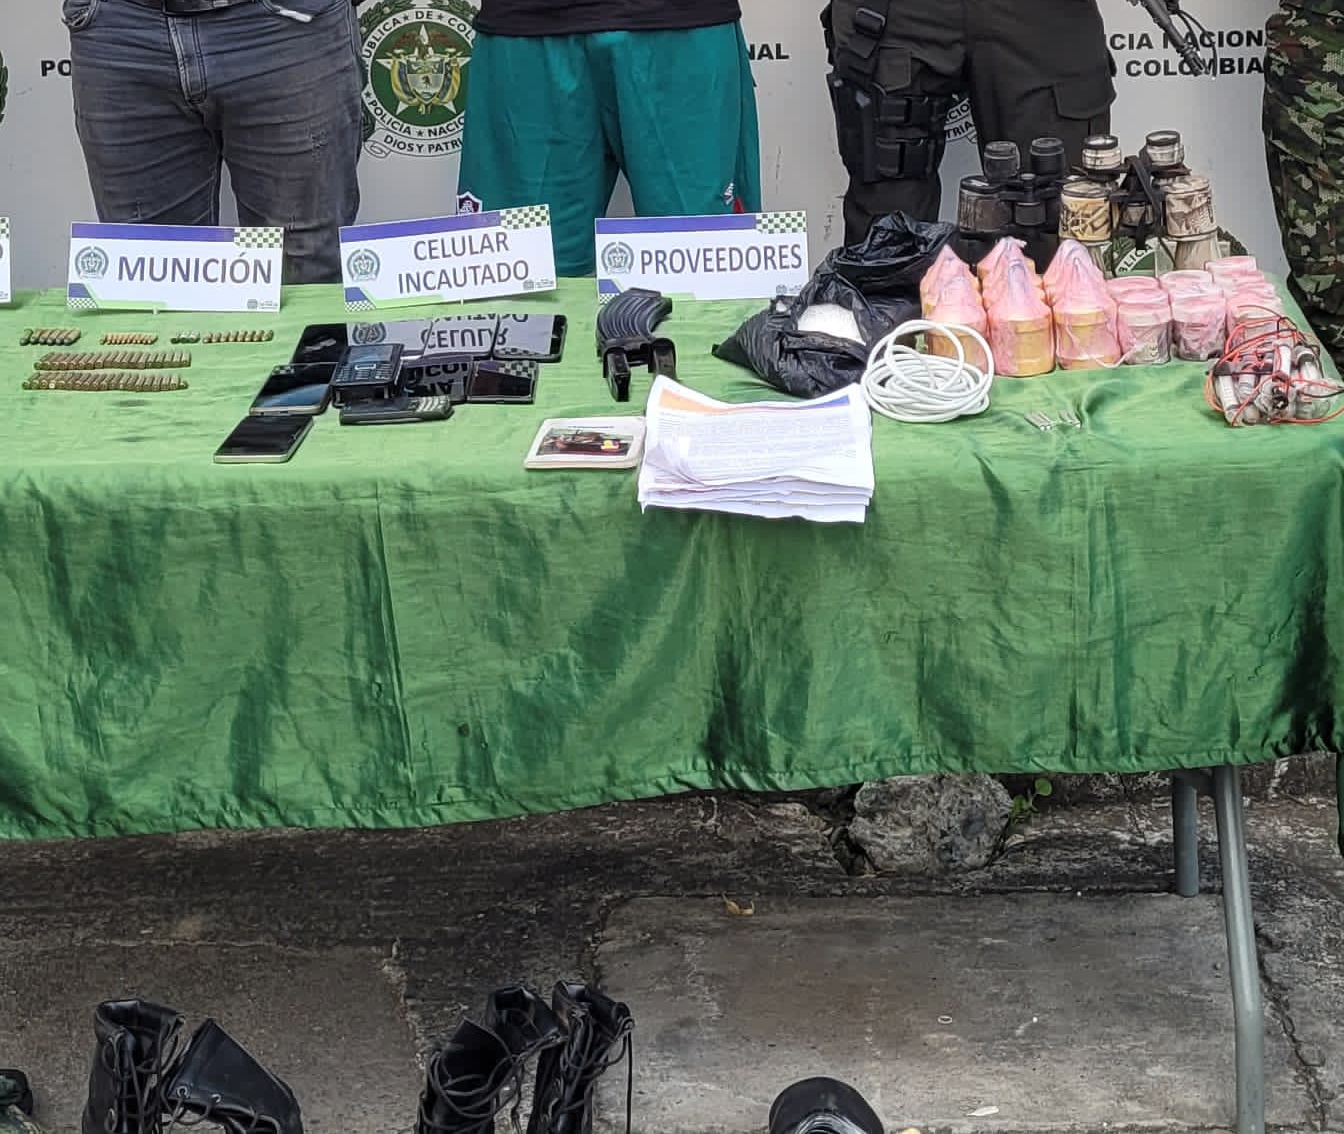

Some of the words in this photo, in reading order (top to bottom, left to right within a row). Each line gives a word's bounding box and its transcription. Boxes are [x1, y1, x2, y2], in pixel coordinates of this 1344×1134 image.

[414, 231, 509, 261] CELULAR
[641, 244, 802, 274] PROVEEDORES
[118, 252, 272, 284] MUNICIÓN
[398, 260, 529, 294] INCAUTADO
